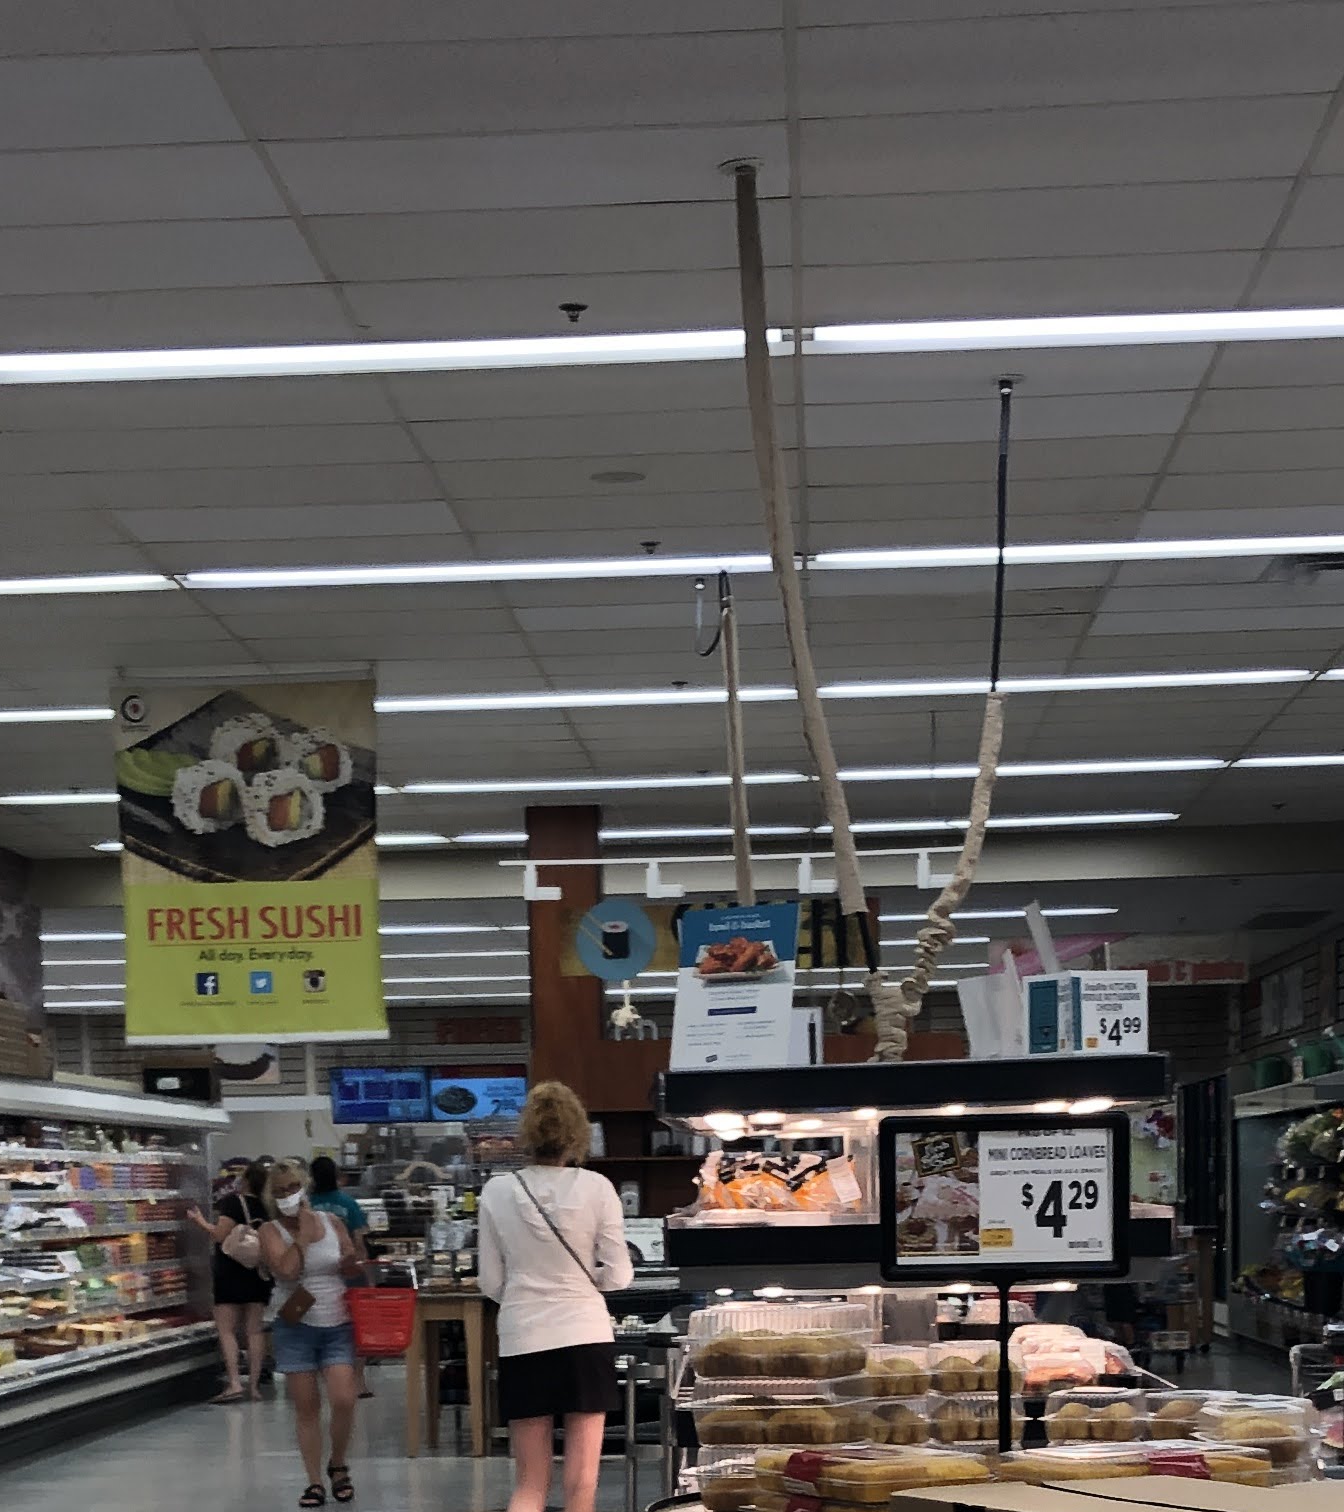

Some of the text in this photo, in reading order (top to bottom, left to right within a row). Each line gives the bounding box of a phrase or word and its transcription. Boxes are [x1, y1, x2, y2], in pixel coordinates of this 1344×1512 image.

[147, 903, 363, 941] FRESH SUSHI
[198, 949, 216, 961] All
